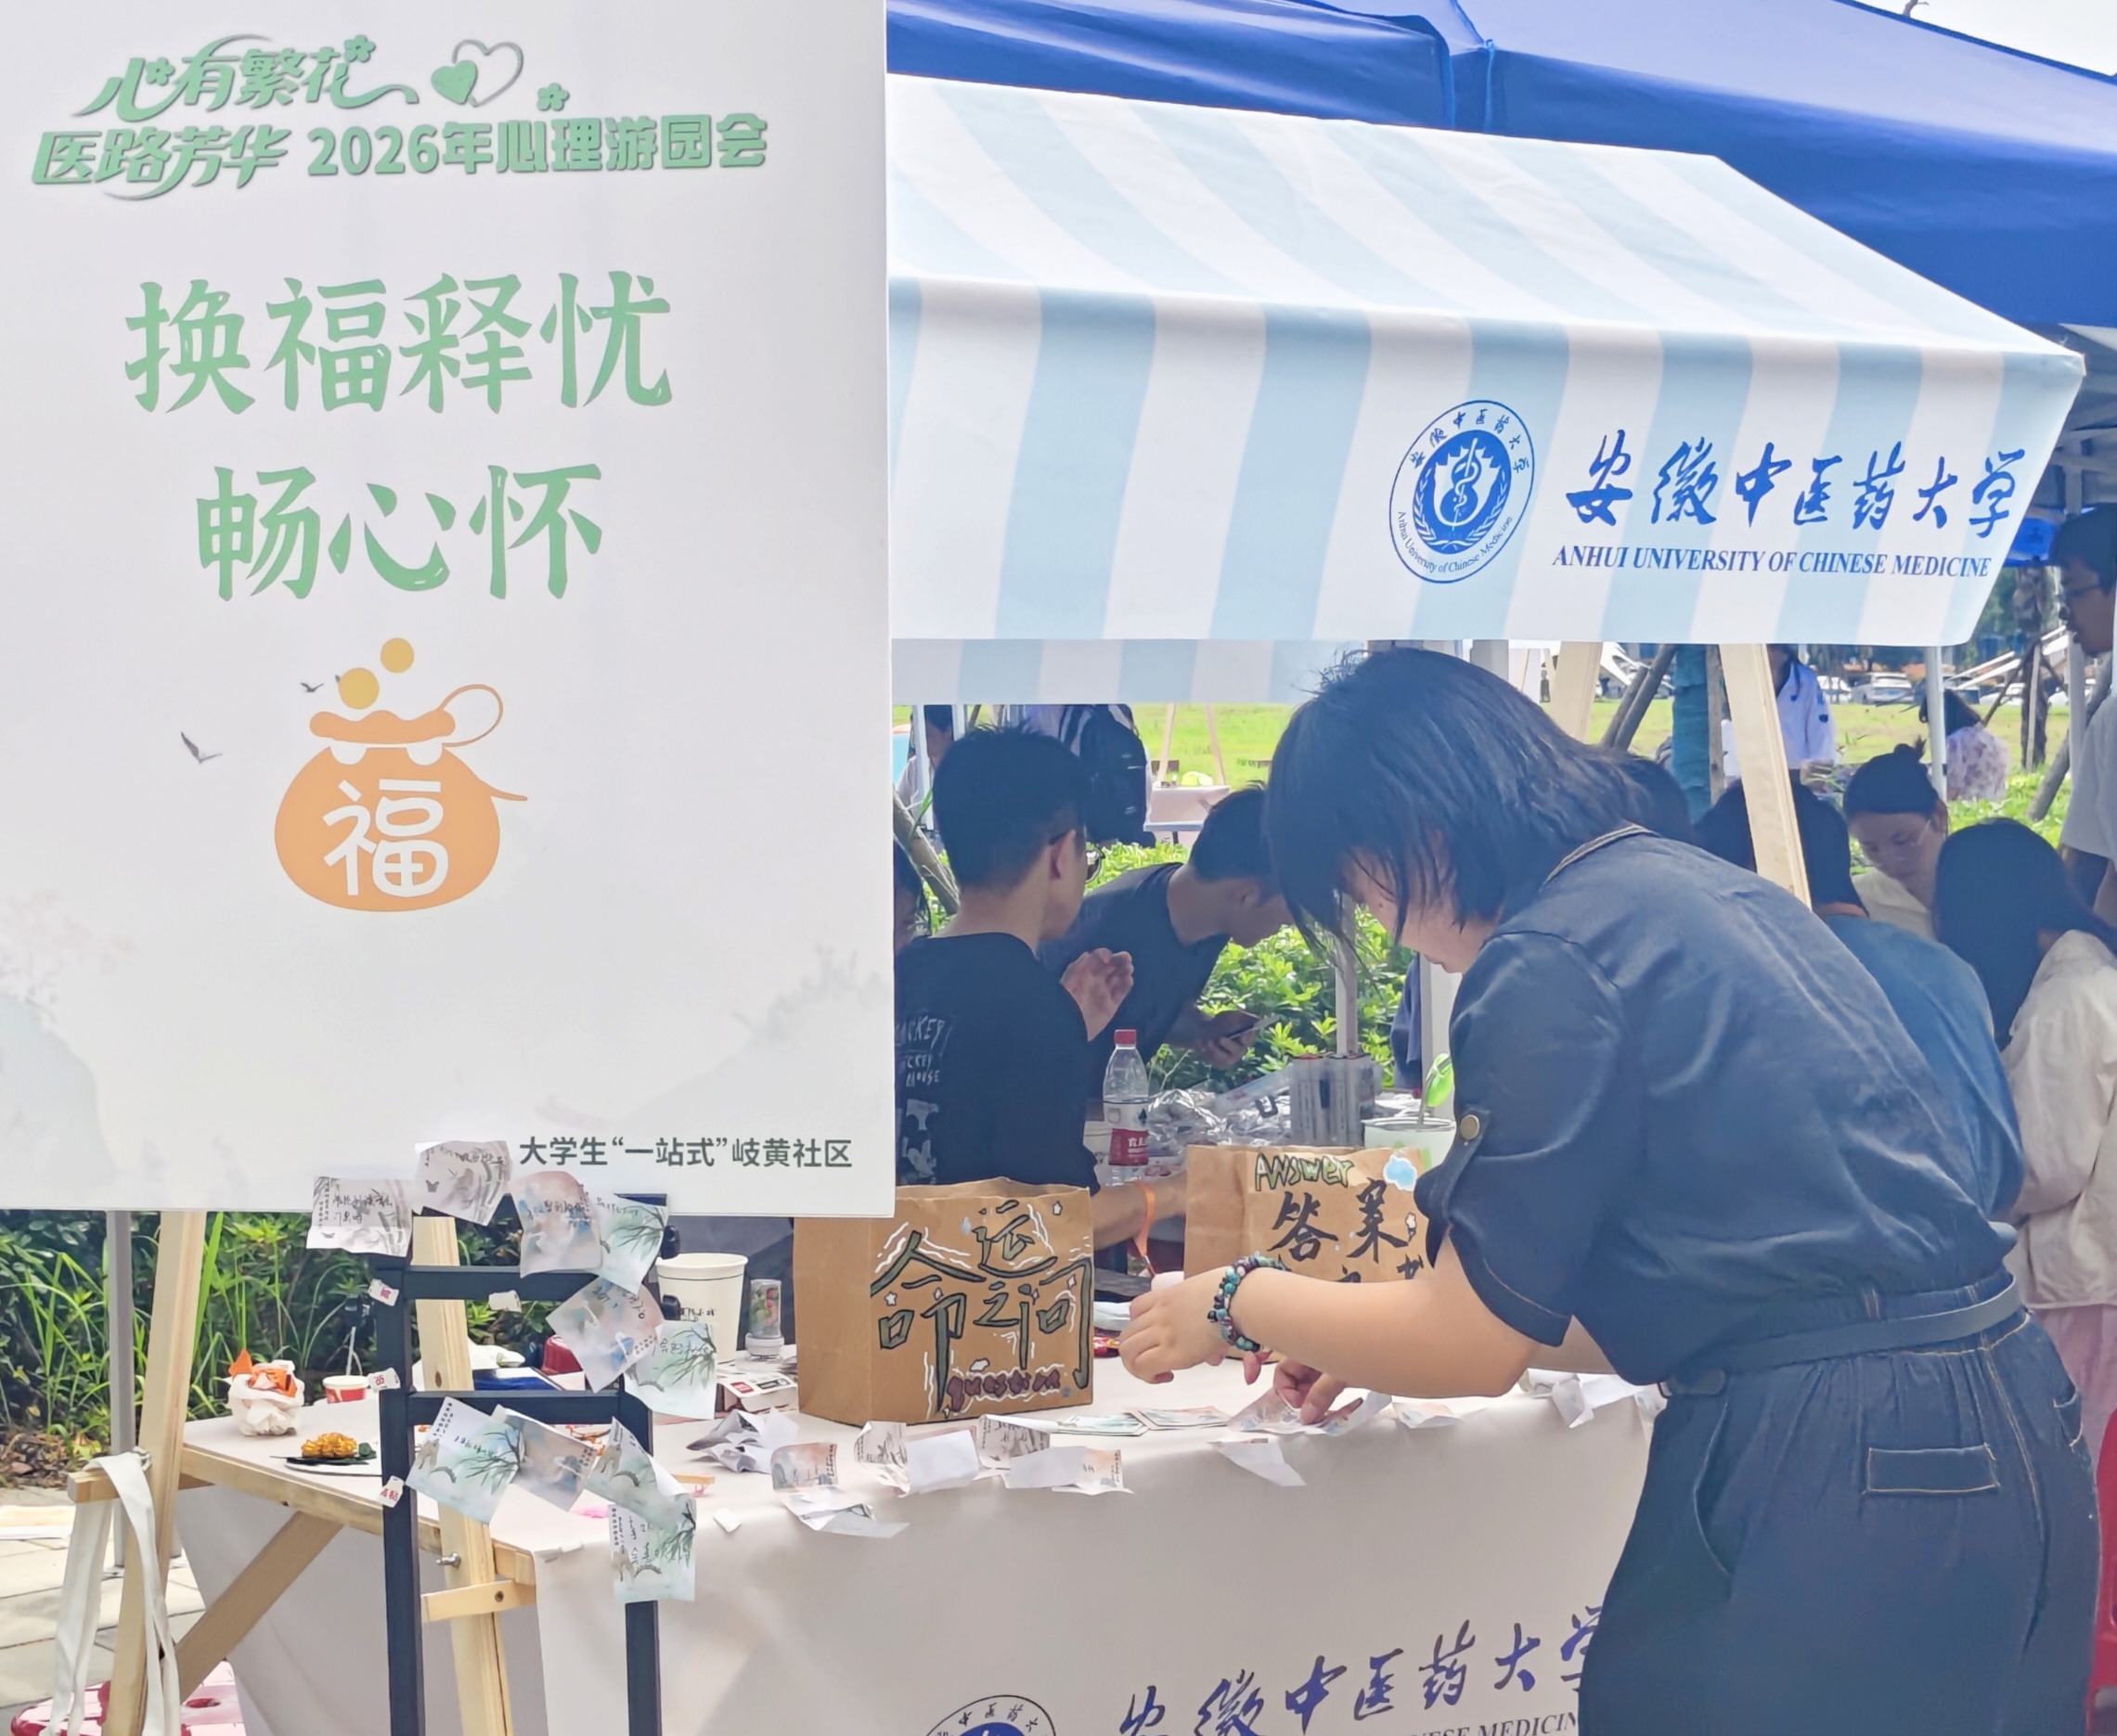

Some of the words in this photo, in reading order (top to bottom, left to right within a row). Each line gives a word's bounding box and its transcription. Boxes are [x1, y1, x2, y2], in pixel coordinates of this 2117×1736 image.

[71, 33, 420, 122] 心有繁花
[31, 124, 291, 200] 医路芳华
[305, 112, 768, 176] 2026年心理游园会
[124, 270, 673, 414] 换福释忧
[1565, 429, 2027, 539] 安徽中医药大学
[196, 463, 602, 601] 畅心怀
[1439, 563, 1449, 573] of
[1448, 554, 1480, 573] Chinese
[1552, 546, 1630, 568] ANHUI
[1633, 547, 1765, 572] UNIVERSITY
[1768, 551, 1797, 572] OF
[1798, 552, 1888, 575] CHINESE
[1890, 555, 1993, 578] MEDICINE
[322, 778, 450, 898] 福
[519, 1136, 854, 1169] 大学生“一站式”岐黄社区
[1266, 1177, 1410, 1265] 答案
